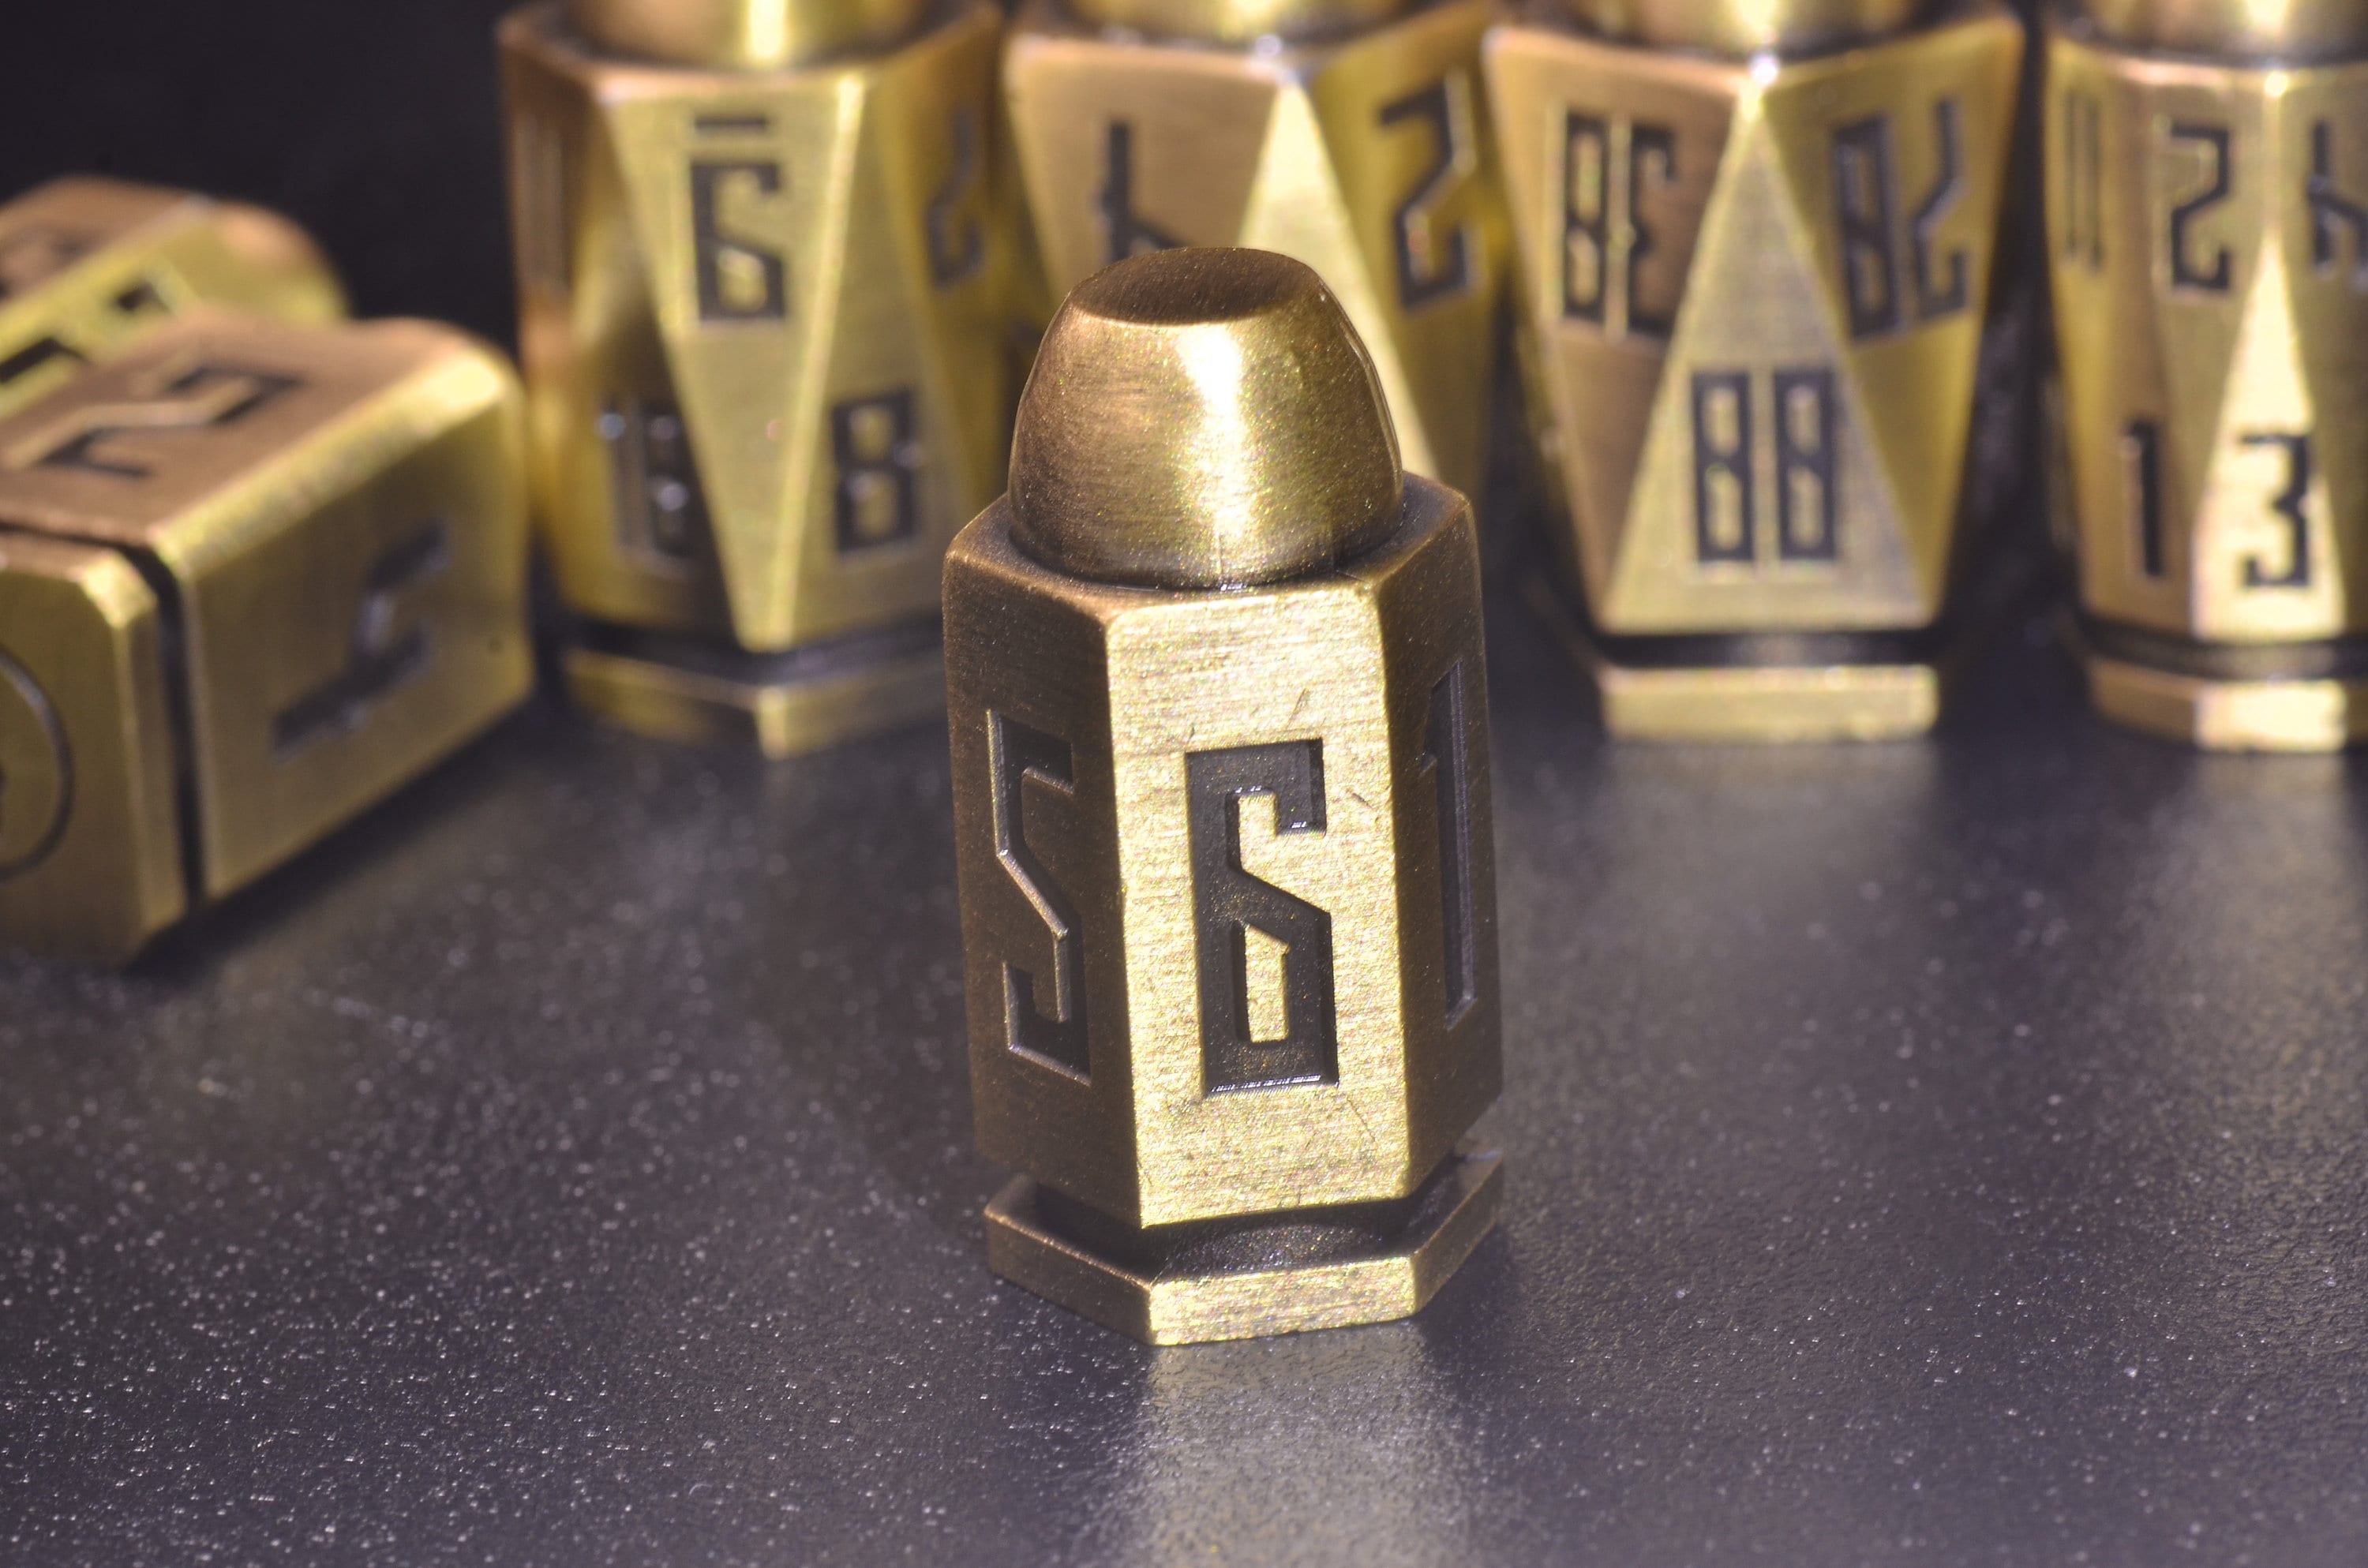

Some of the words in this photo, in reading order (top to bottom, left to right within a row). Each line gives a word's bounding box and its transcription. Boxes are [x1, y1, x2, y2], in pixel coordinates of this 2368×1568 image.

[2242, 434, 2313, 588] 3
[987, 709, 1092, 1087] 5
[1184, 738, 1339, 1098] 6
